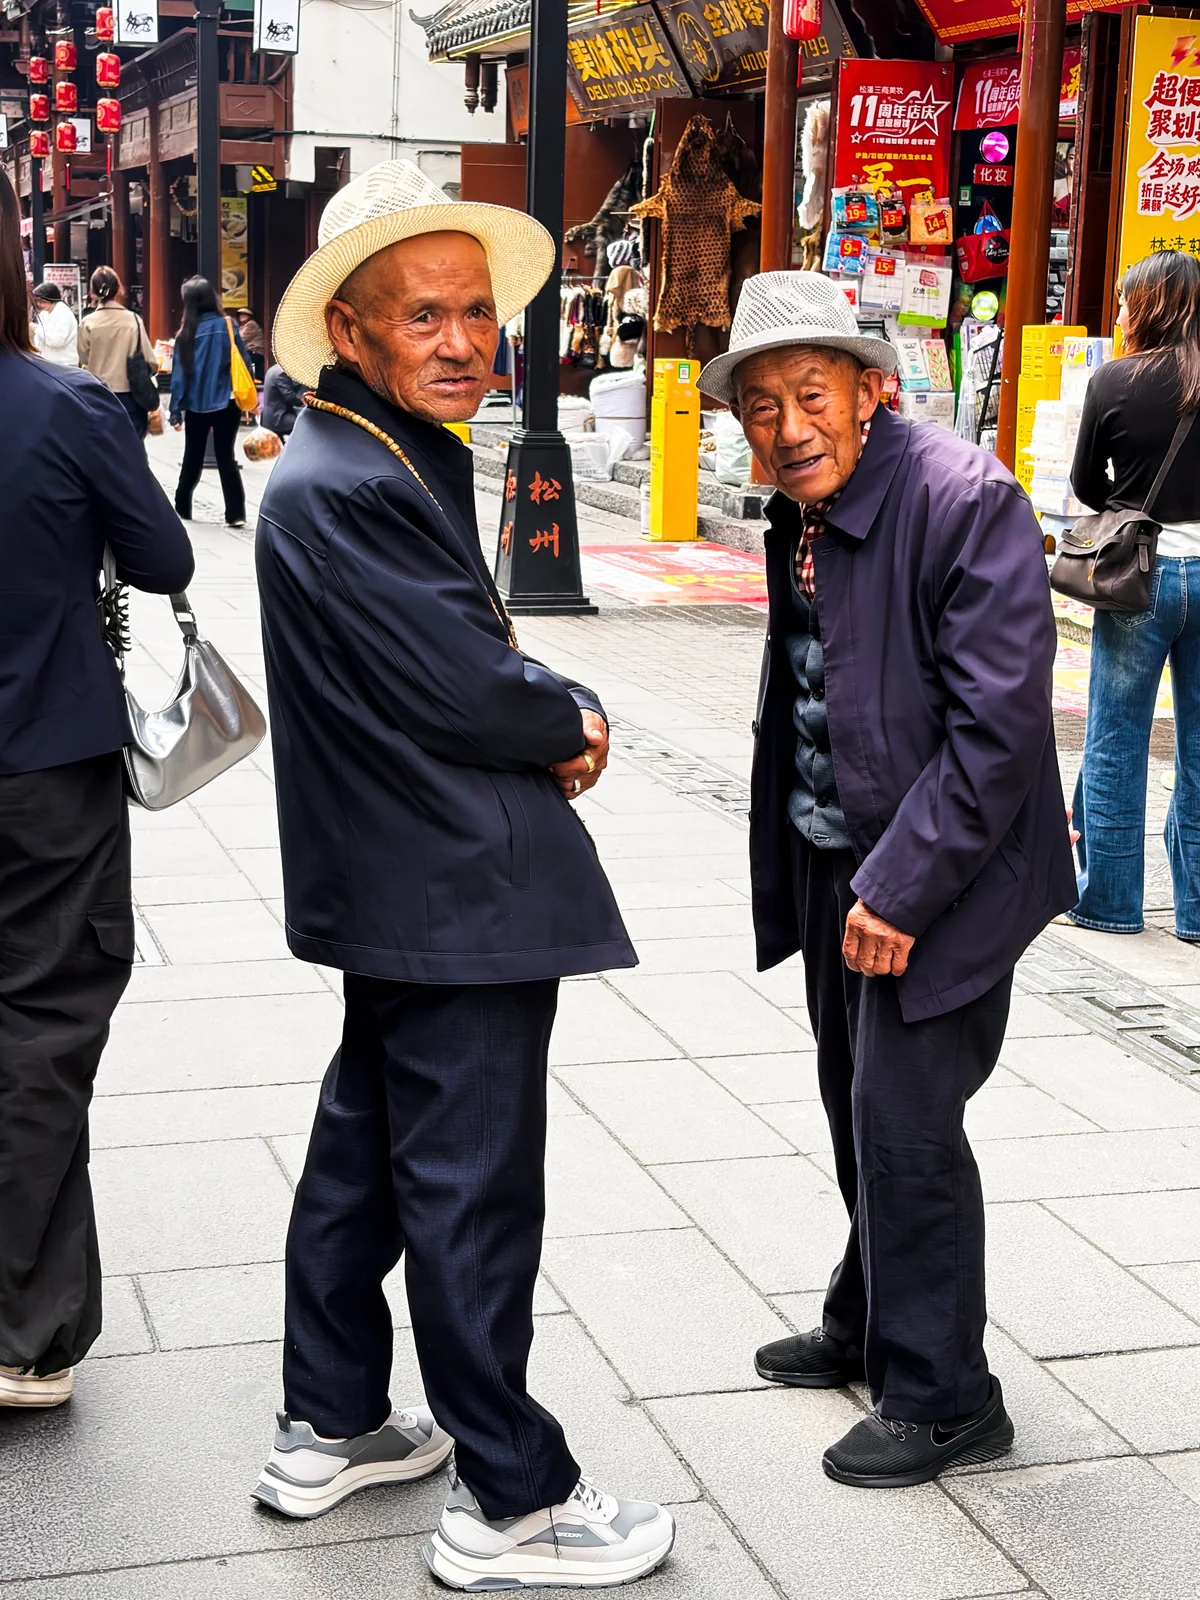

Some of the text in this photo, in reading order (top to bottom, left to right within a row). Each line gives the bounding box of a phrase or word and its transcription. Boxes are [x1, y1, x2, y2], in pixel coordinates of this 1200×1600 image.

[703, 0, 771, 37] 全球零
[567, 22, 671, 82] 美味码头
[586, 71, 680, 101] DELICIOUSDOCK
[980, 167, 1008, 182] 化妆
[528, 470, 562, 558] 松州
